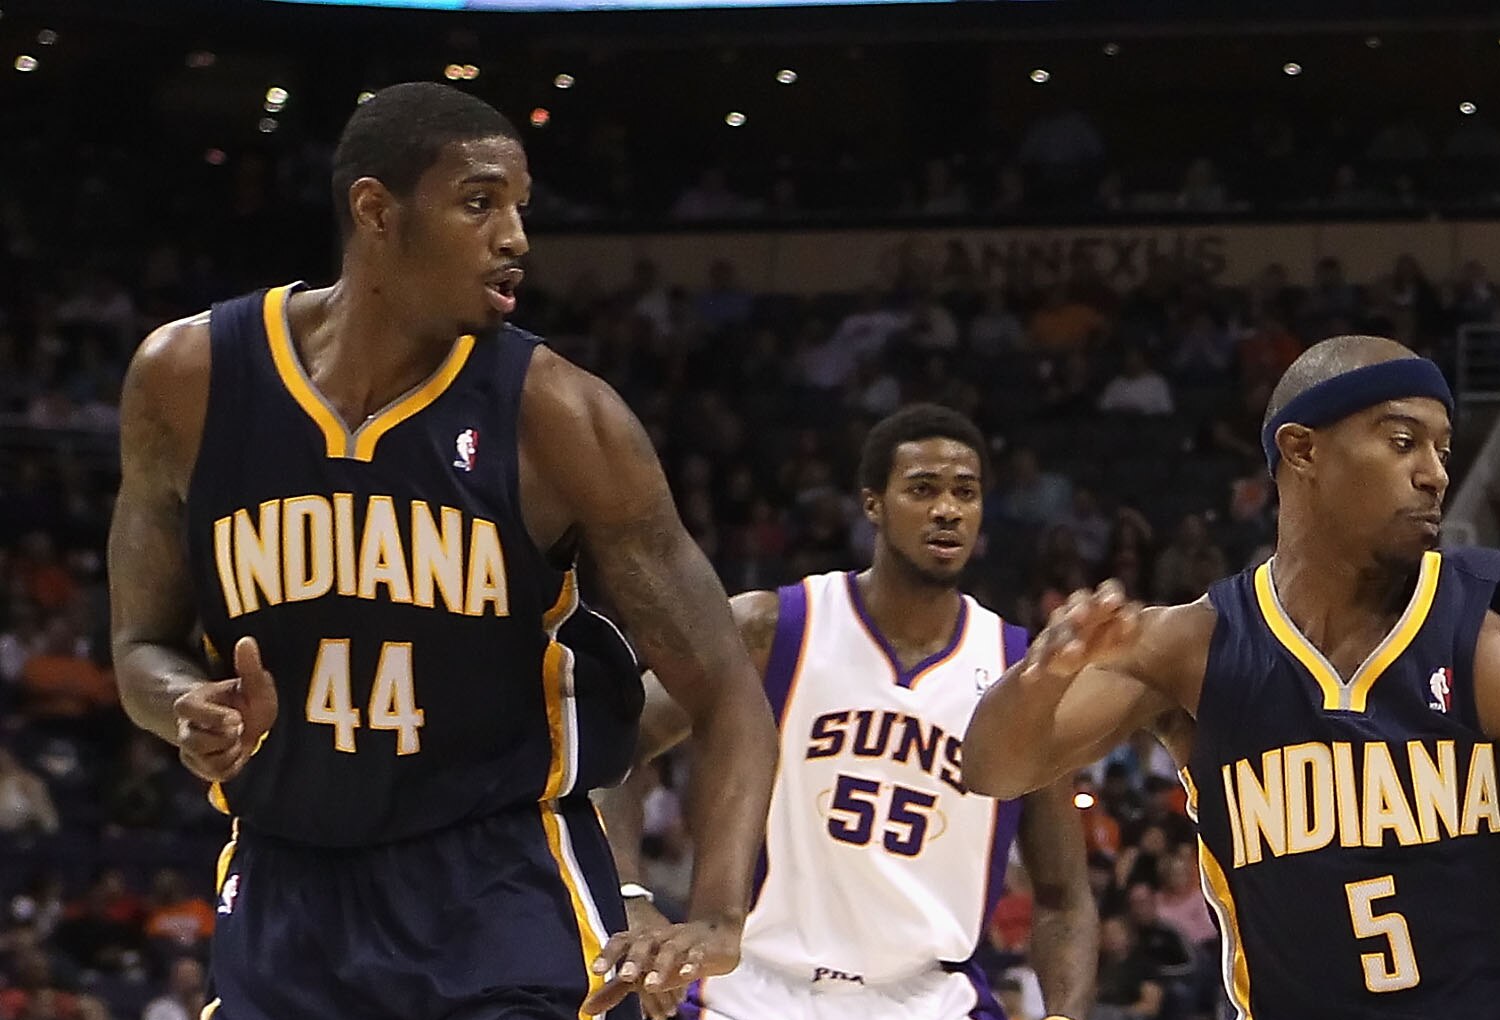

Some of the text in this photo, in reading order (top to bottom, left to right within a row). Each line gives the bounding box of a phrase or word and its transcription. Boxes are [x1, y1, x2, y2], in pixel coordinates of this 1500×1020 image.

[214, 492, 510, 619] INDIANA
[306, 638, 425, 755] 44
[805, 710, 968, 796] SUNS
[828, 774, 938, 858] 55
[1345, 875, 1420, 993] 5
